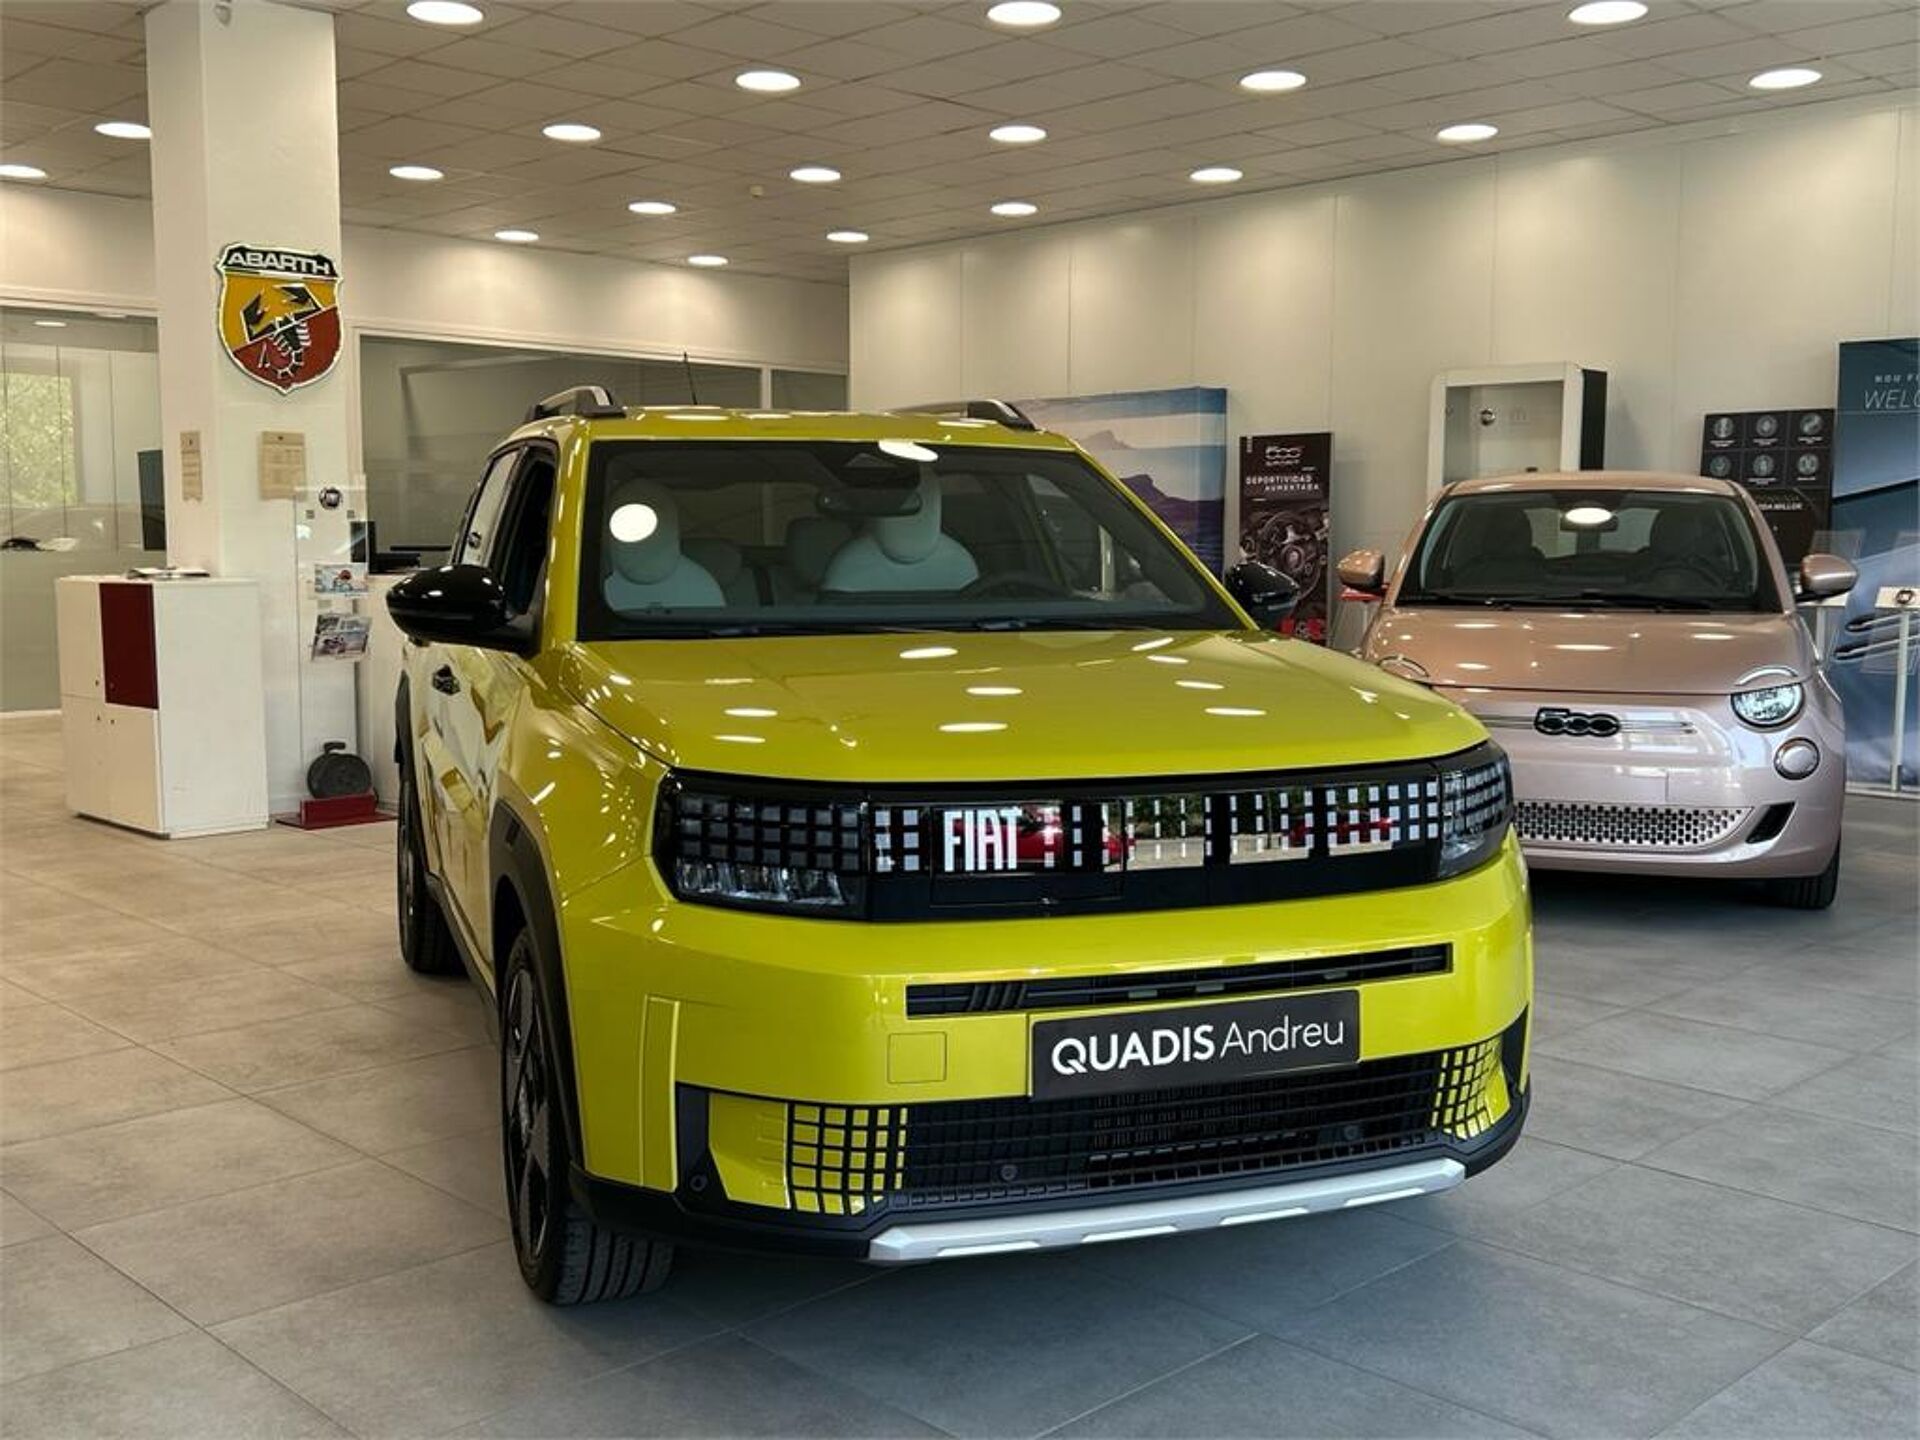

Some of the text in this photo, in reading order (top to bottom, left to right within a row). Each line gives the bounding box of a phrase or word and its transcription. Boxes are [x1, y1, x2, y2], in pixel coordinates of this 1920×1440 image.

[227, 252, 331, 275] ABARTH
[1245, 474, 1312, 485] DEPORTIVIDAD
[1264, 483, 1319, 492] AUMENTADA
[1534, 707, 1620, 737] 500
[944, 808, 1022, 873] FIAT
[1051, 1015, 1344, 1075] QUADIS Andreu
